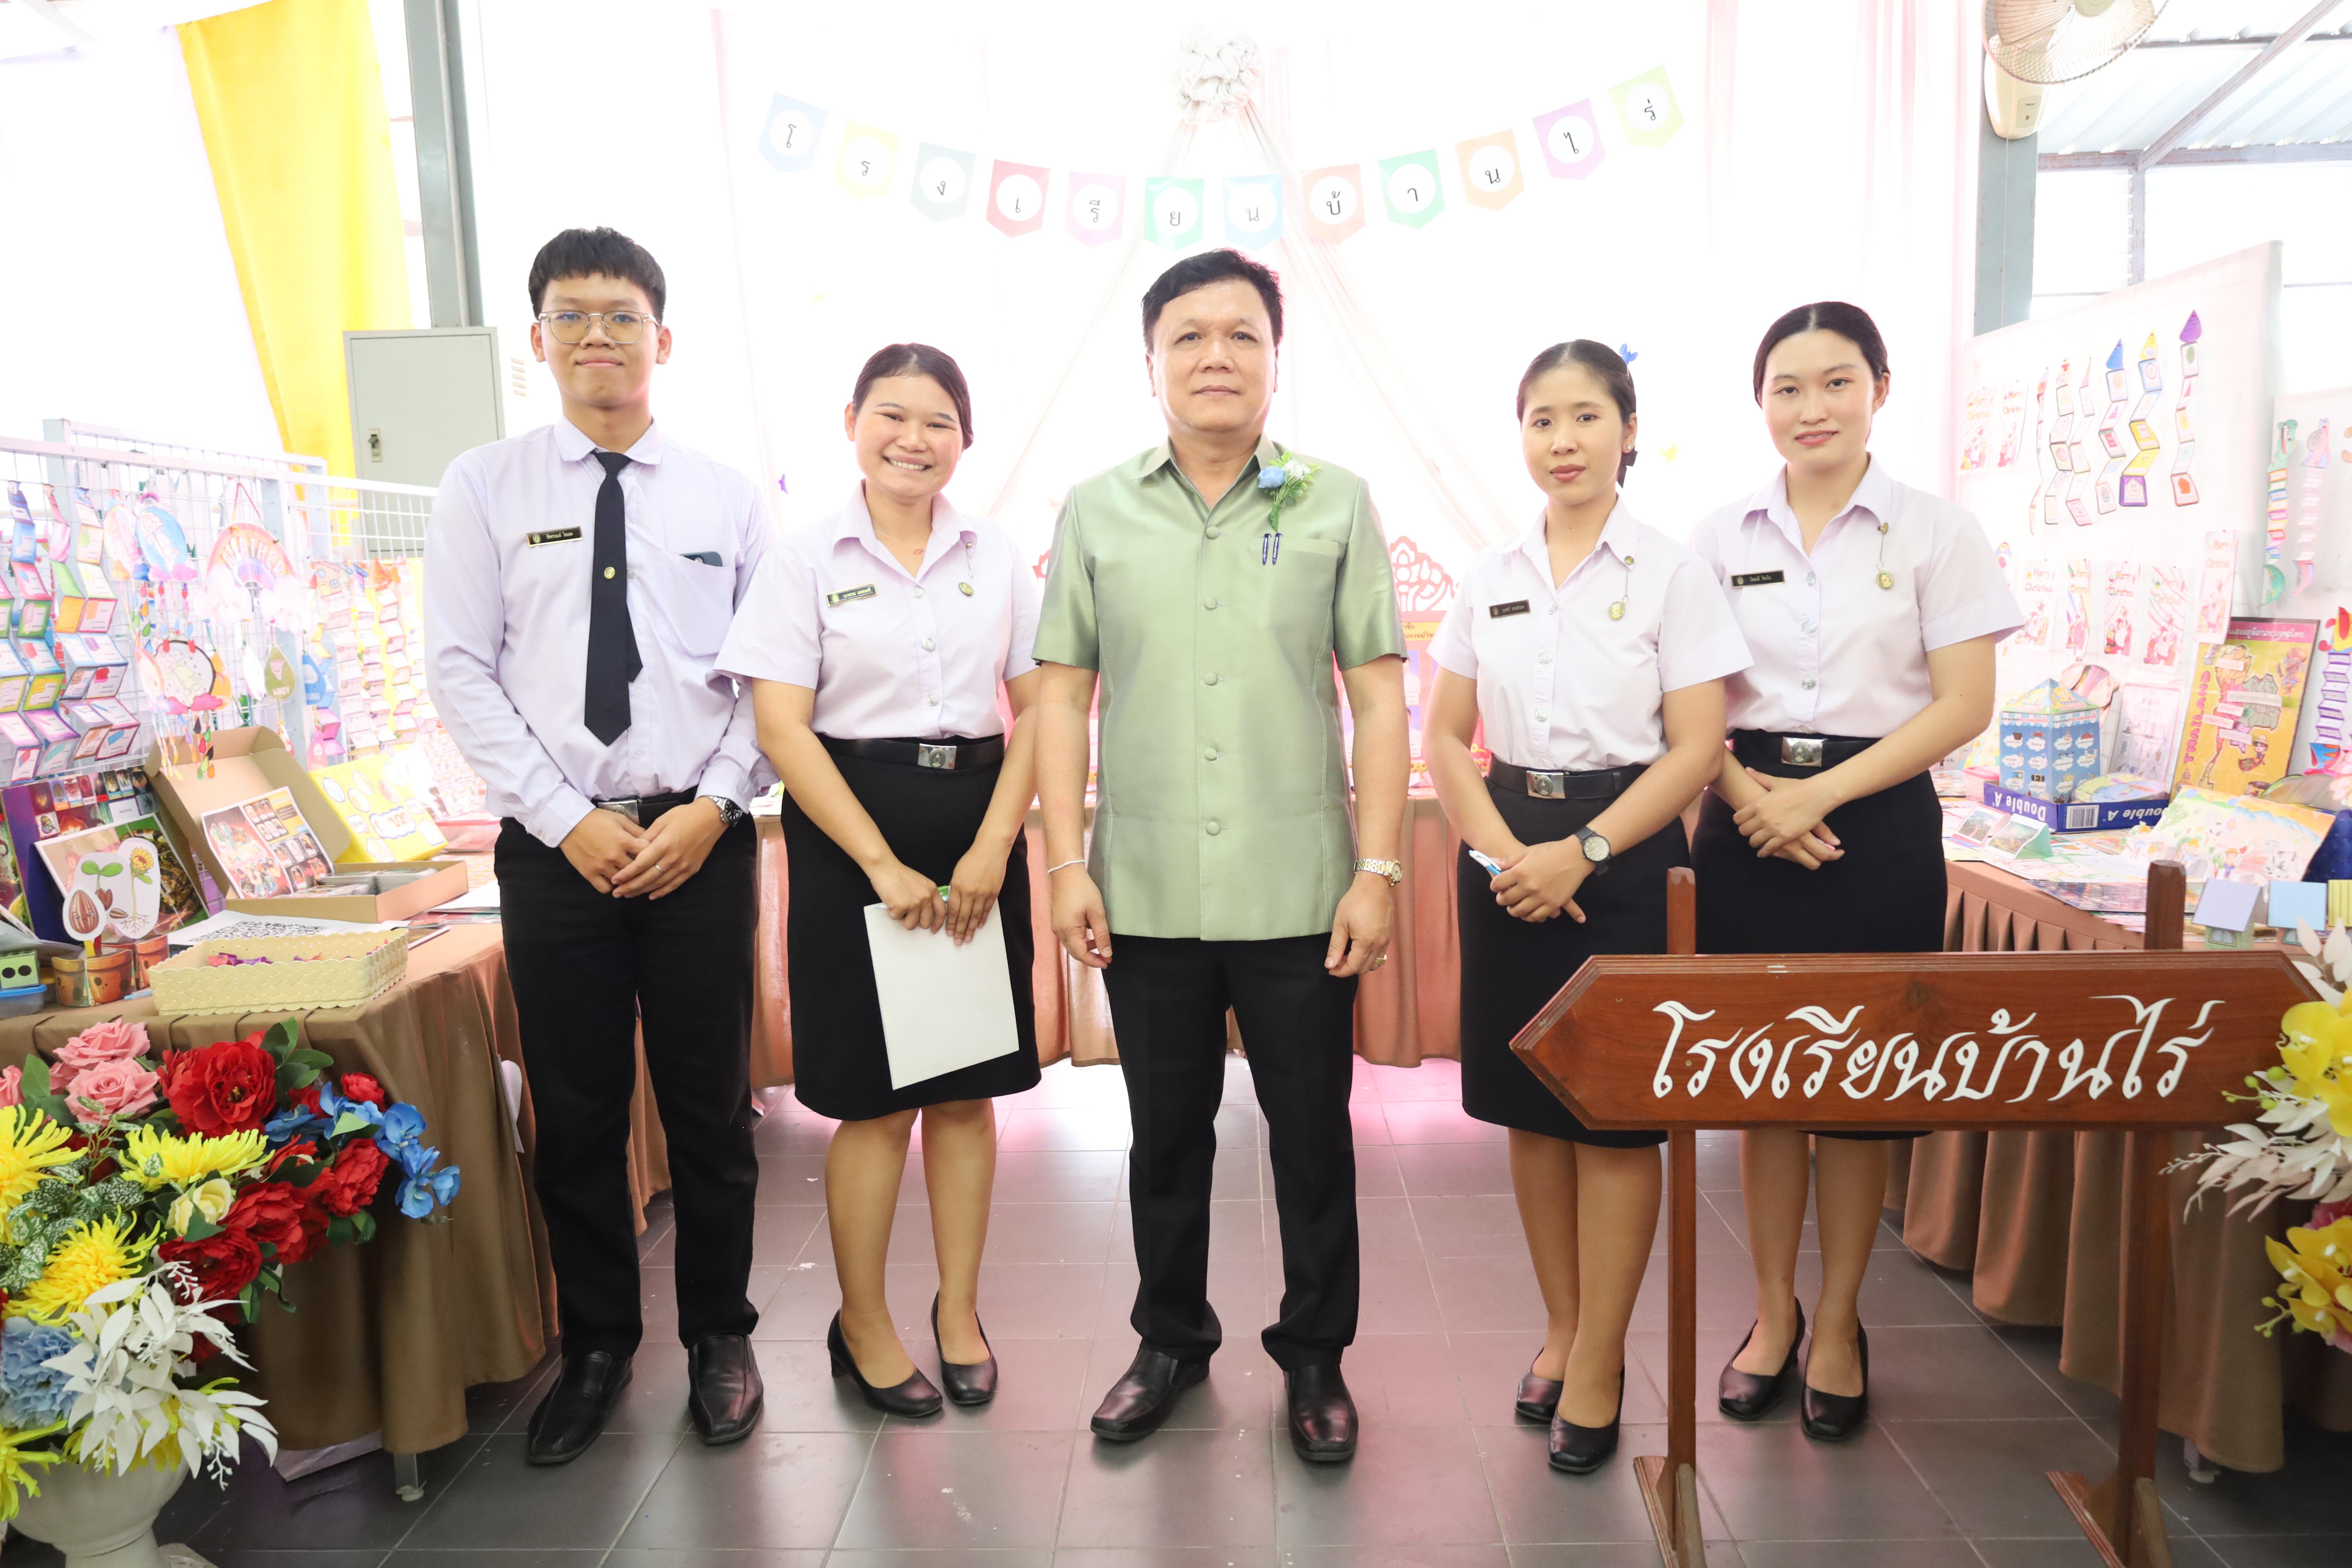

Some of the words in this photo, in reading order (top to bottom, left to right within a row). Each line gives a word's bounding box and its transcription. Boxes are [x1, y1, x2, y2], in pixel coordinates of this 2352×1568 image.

[221, 535, 285, 579] WEATHER
[2184, 670, 2211, 764] THAILAND
[1994, 792, 2003, 807] A
[2006, 795, 2046, 822] Double
[2108, 810, 2119, 821] A
[2122, 807, 2164, 820] ouble
[1652, 994, 2225, 1102] โรงเรียนบ้านไร่
